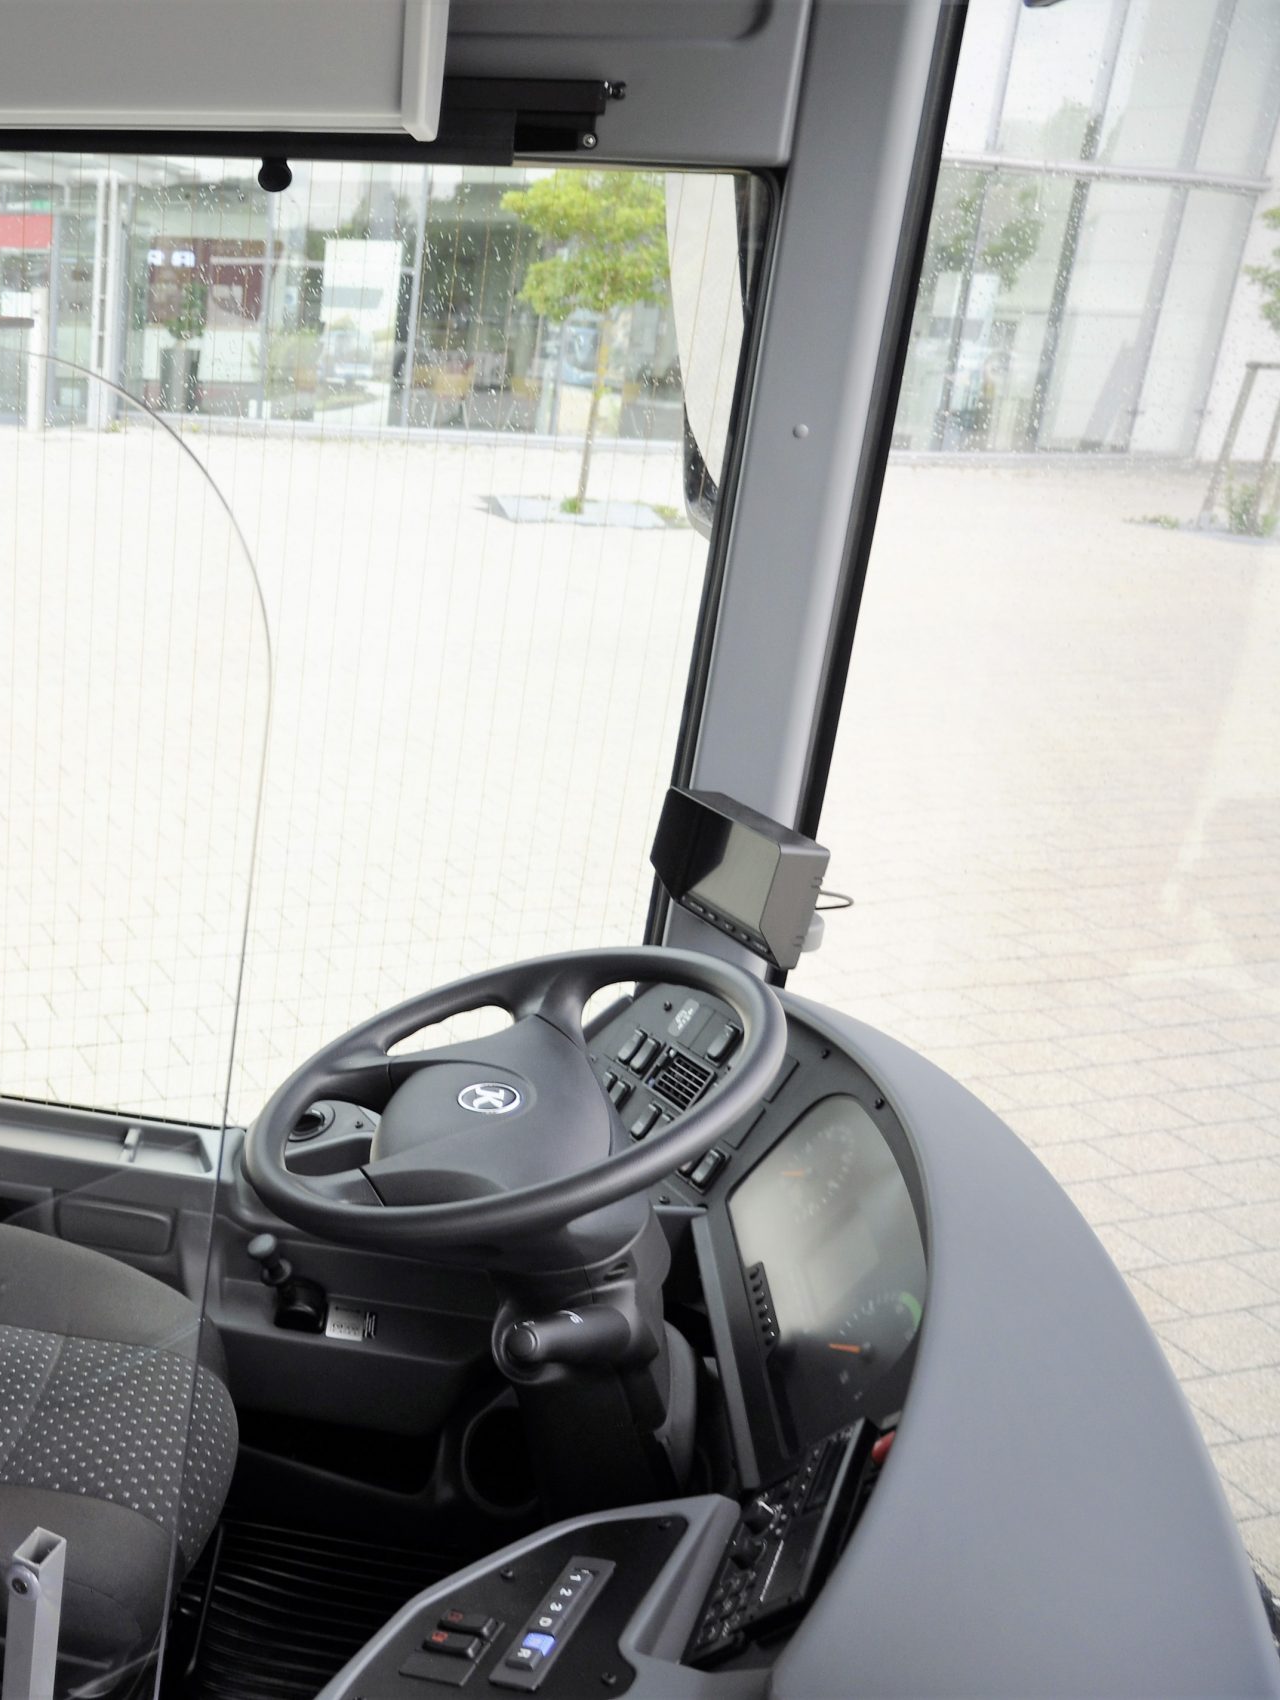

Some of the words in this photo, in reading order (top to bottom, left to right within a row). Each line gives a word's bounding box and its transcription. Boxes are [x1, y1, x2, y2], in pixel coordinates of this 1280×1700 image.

[569, 1574, 582, 1582] 1
[559, 1587, 573, 1597] 2
[549, 1602, 563, 1612] 3
[517, 1647, 532, 1659] R
